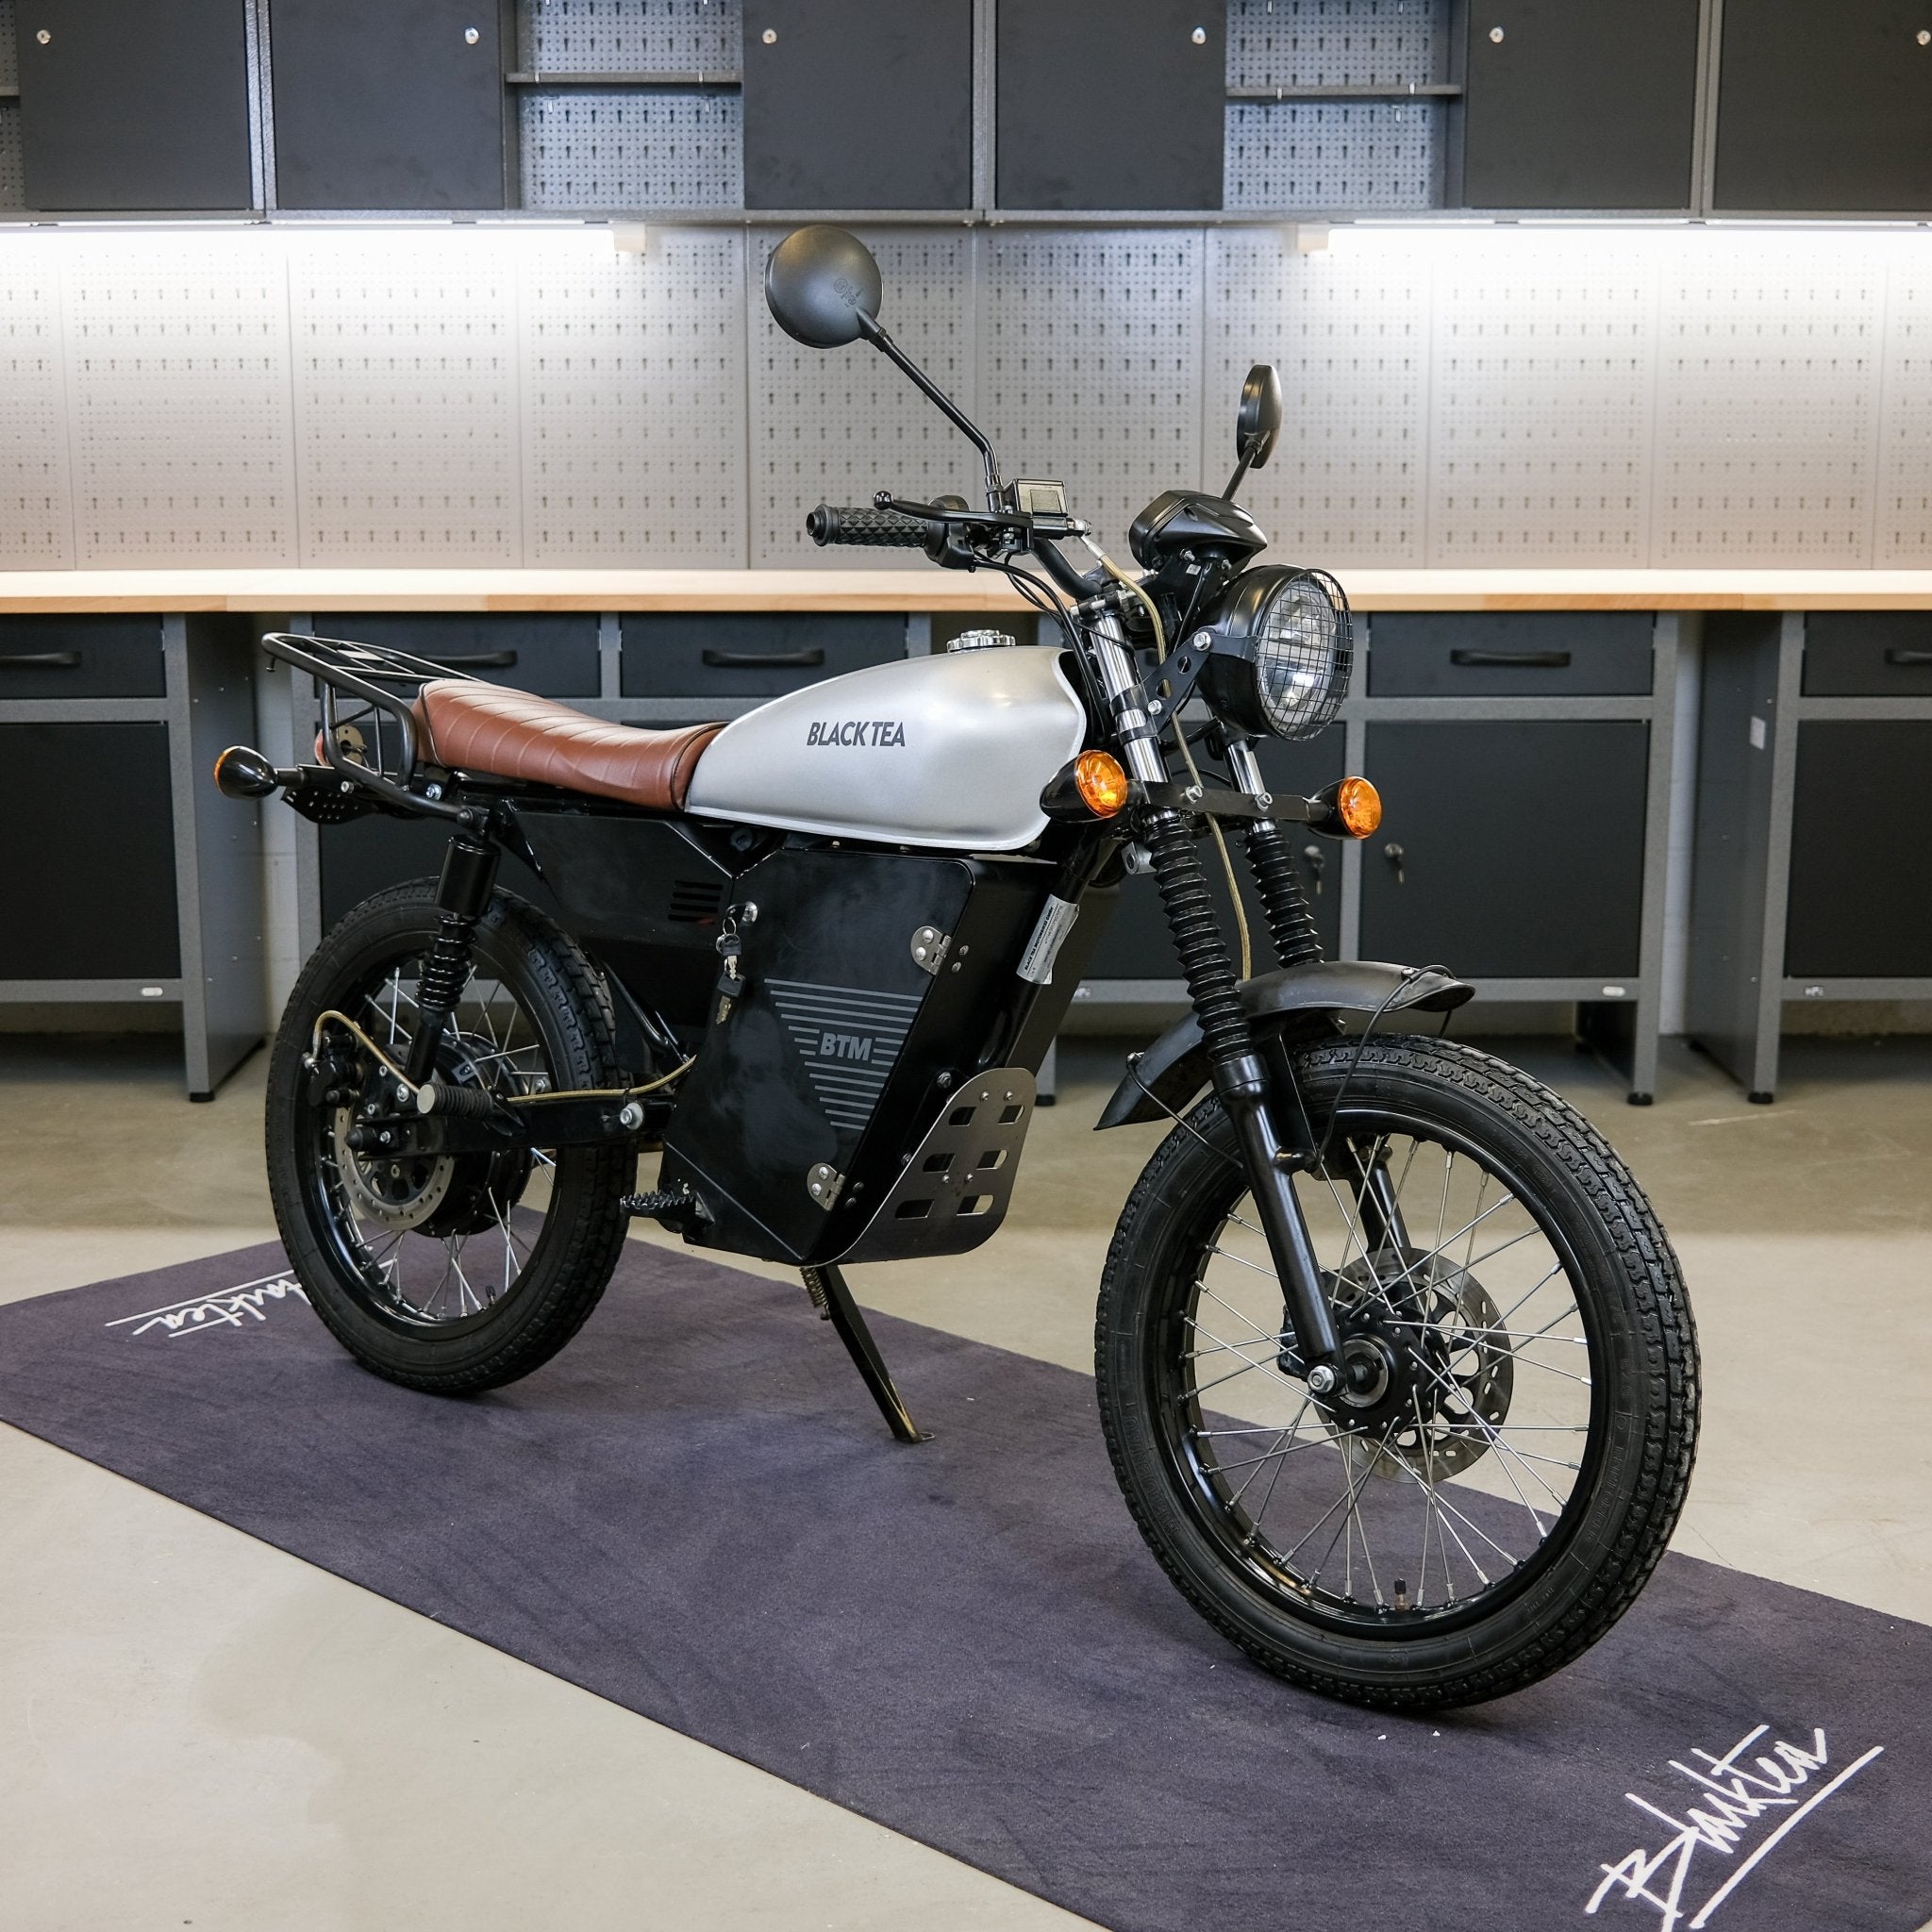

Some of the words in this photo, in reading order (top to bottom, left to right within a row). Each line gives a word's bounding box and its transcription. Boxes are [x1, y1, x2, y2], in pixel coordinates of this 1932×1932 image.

[807, 721, 870, 746] BLACK
[871, 721, 906, 747] TEA
[1024, 956, 1033, 971] BLACK
[820, 1032, 873, 1061] BTM
